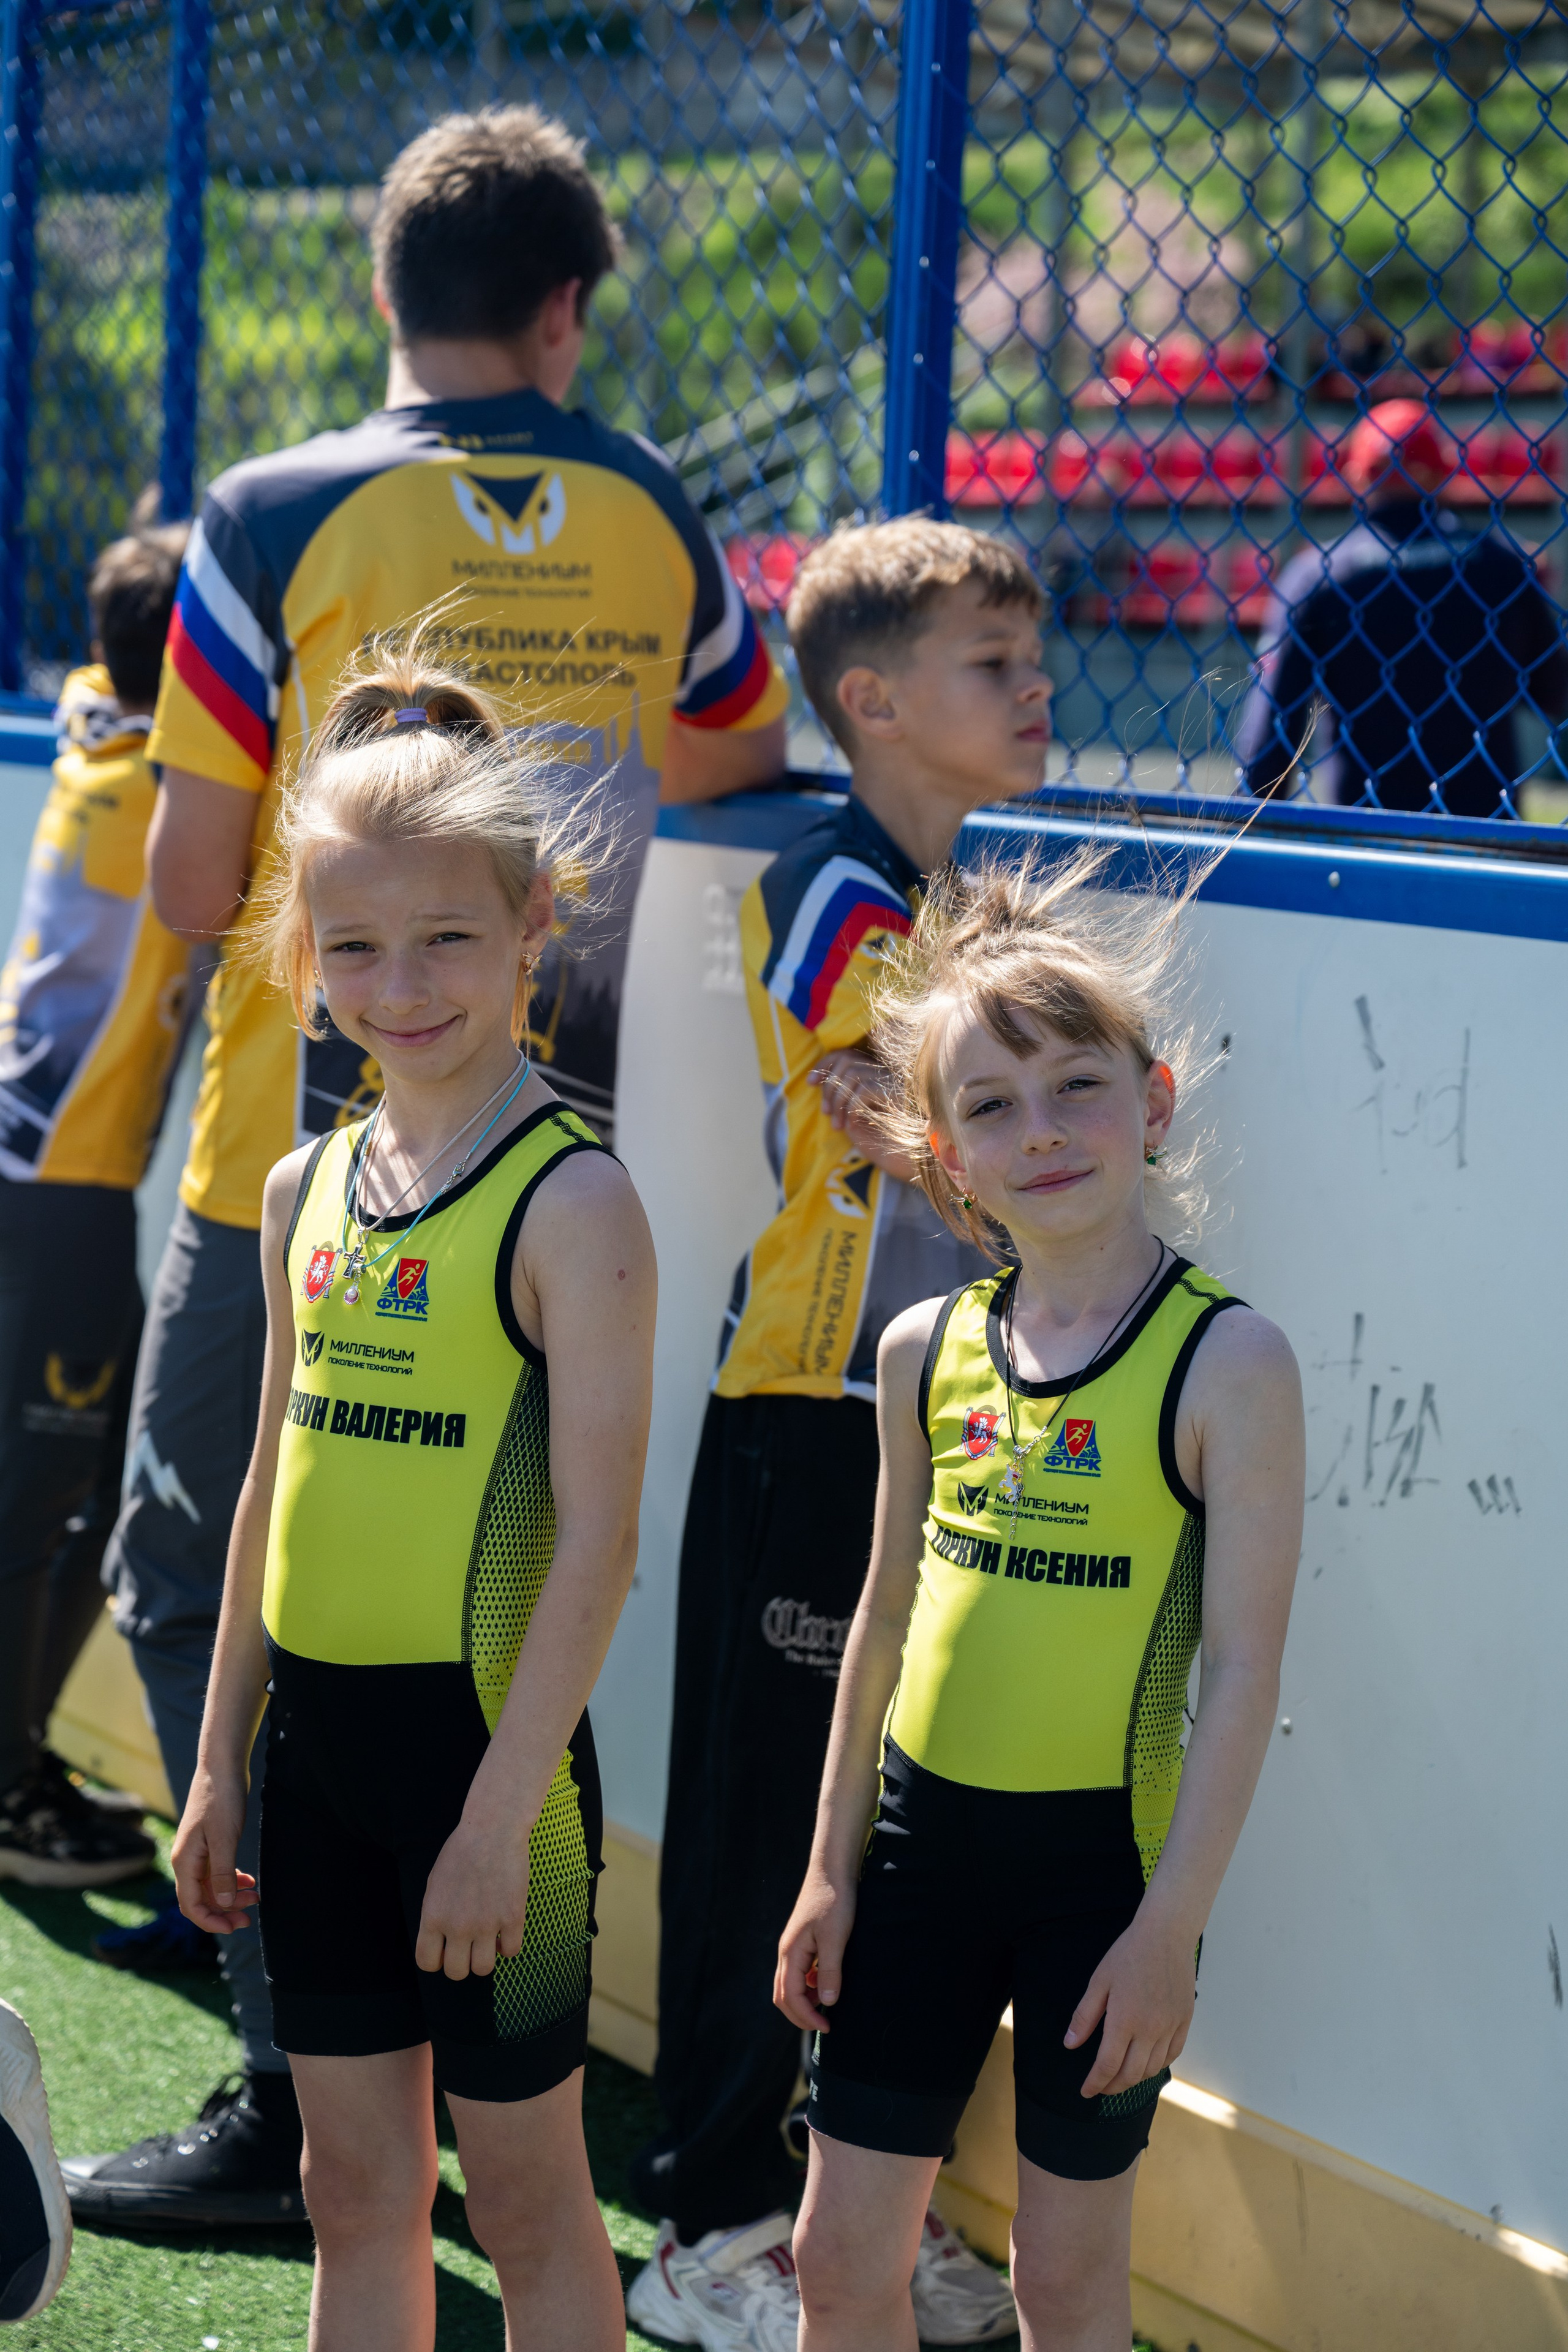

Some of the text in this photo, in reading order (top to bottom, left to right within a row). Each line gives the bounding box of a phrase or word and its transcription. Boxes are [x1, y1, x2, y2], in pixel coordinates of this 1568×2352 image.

[586, 630, 662, 656] КРЫМ
[376, 1297, 430, 1315] ФТРК
[330, 1339, 415, 1363] МИЛЛЕНИУМ
[328, 1357, 413, 1376] ПОКОЛЕНИЕ ТЕХНОЛОГИЙ
[285, 1387, 467, 1448] РКУН ВАЛЕРИЯ
[1044, 1455, 1102, 1471] ФТРК
[1037, 1514, 1088, 1526] ТЕХНОЛОГИЙ
[931, 1525, 1131, 1588] ГОРКУН КСЕНИЯ
